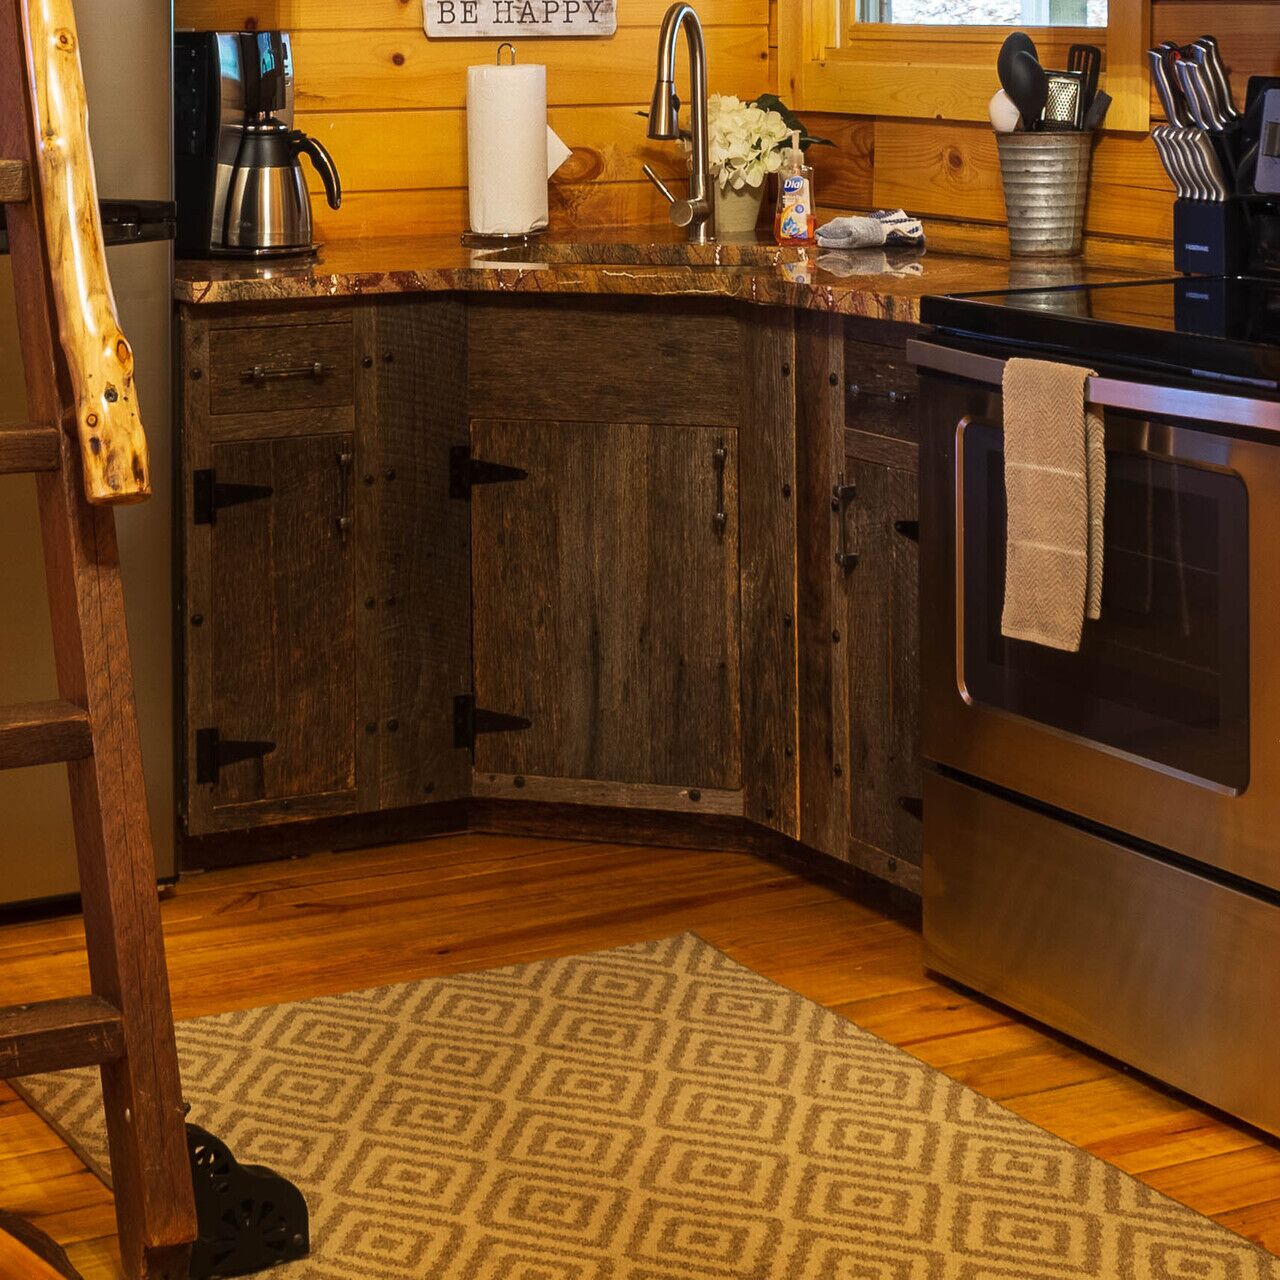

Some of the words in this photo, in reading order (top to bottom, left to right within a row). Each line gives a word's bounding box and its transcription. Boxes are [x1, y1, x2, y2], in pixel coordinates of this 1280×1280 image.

[437, 0, 478, 24] BE
[492, 0, 604, 24] HAPPY
[784, 179, 804, 190] Dial
